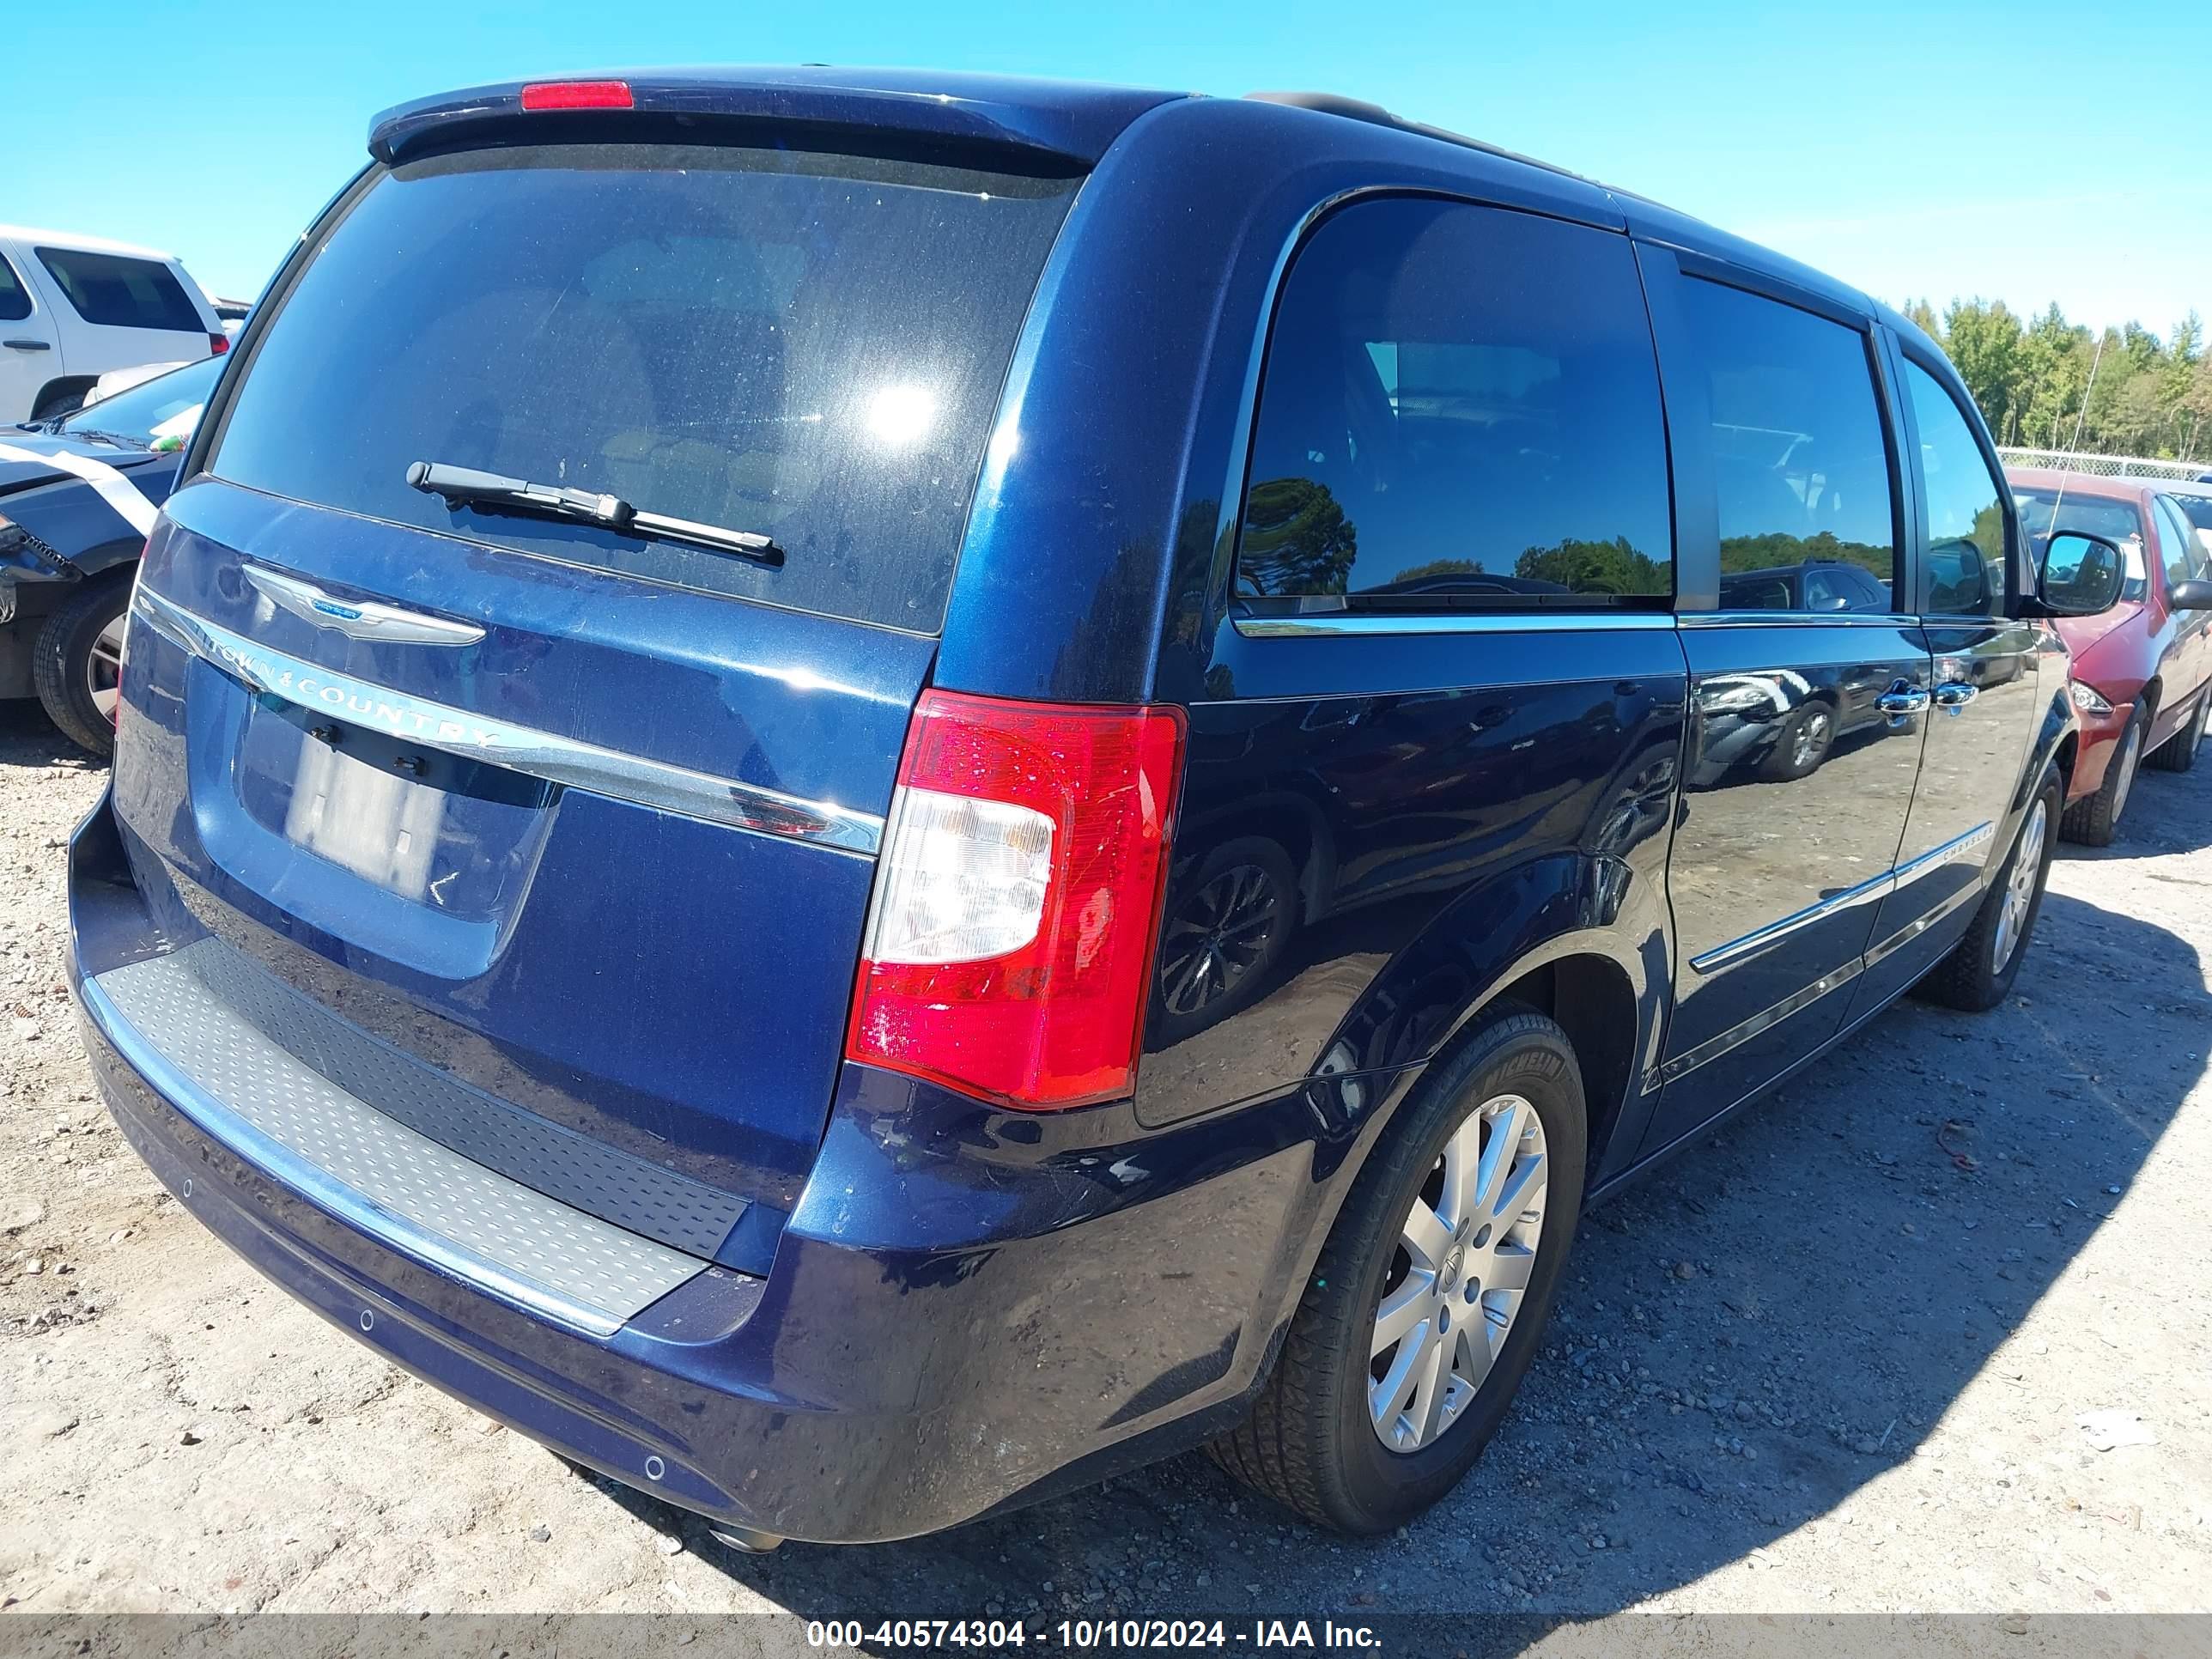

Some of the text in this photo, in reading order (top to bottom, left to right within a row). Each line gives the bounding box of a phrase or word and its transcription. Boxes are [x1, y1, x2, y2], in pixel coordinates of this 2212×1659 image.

[313, 599, 357, 619] CHRYSLER
[1942, 826, 1993, 861] CHRYSLER
[1483, 1050, 1562, 1096] MICHELIN
